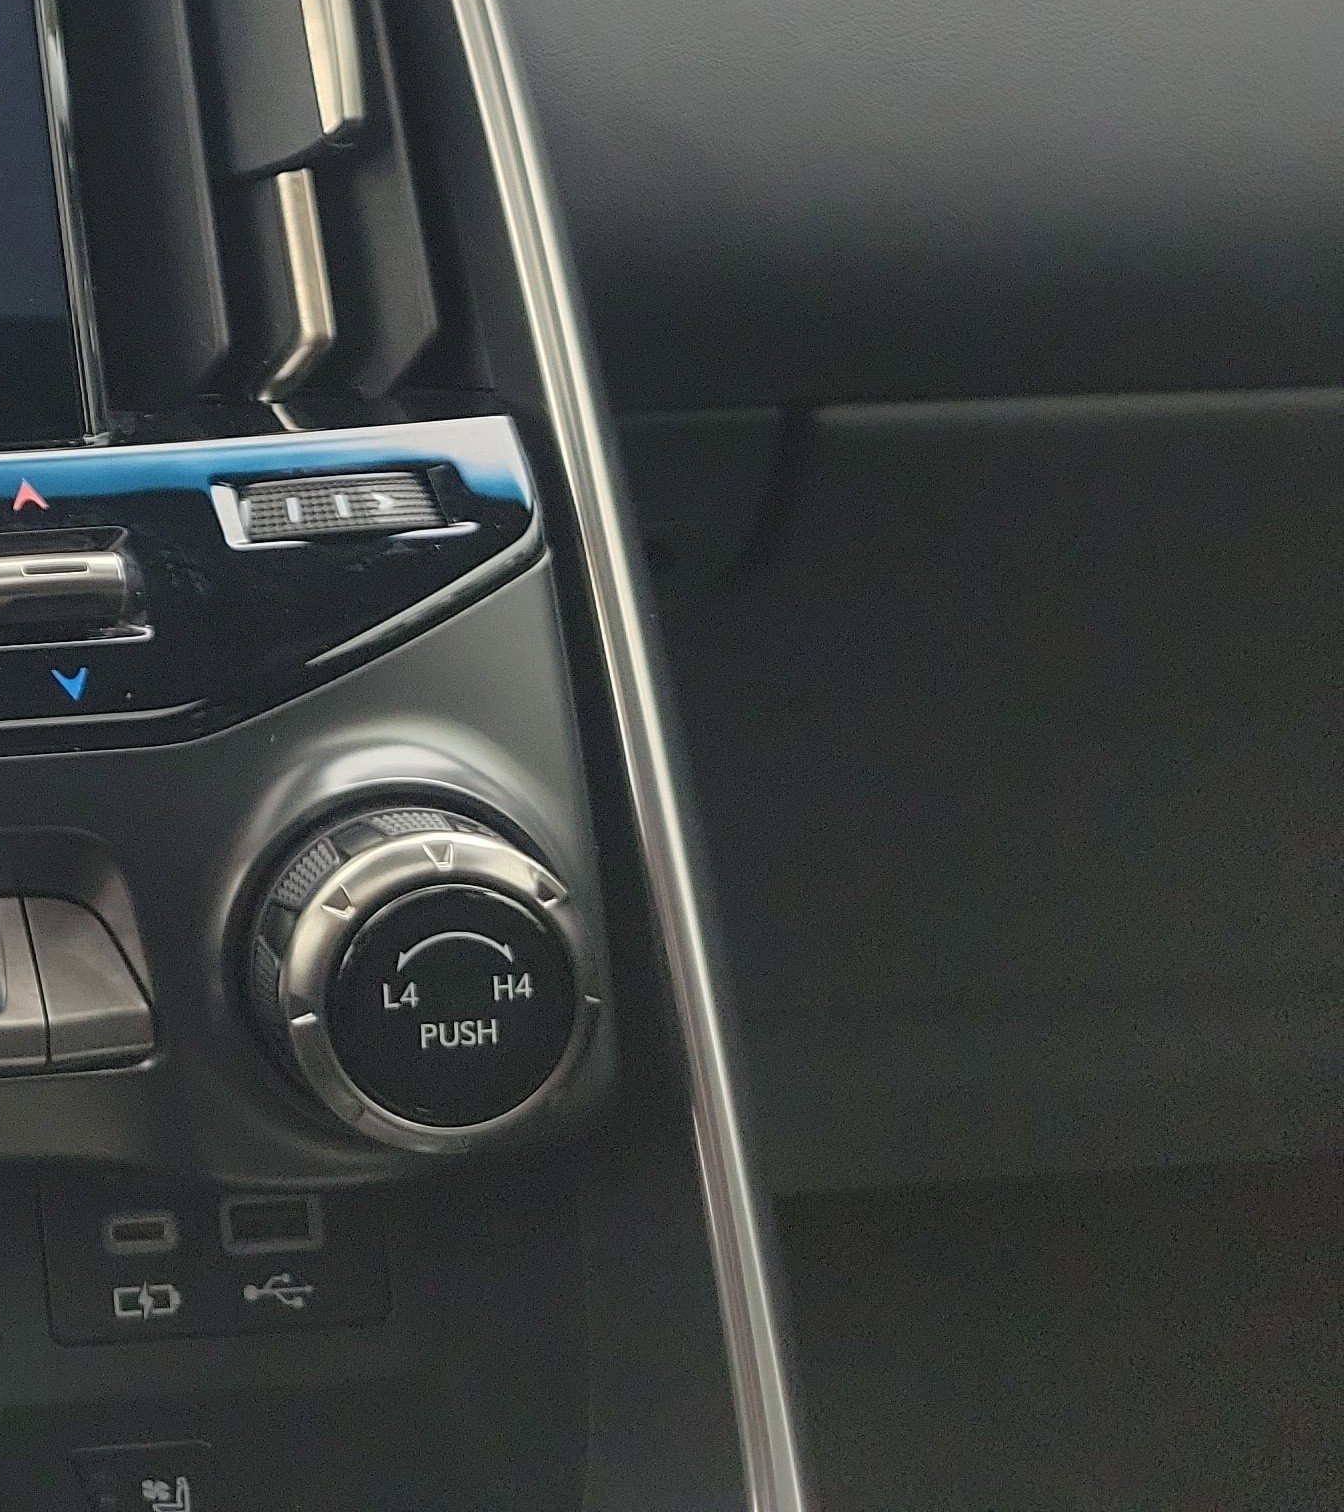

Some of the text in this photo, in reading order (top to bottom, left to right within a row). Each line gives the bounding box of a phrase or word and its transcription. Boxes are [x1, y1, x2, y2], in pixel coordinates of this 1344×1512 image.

[382, 982, 420, 1009] L4
[493, 972, 533, 1002] H4
[420, 1019, 498, 1048] PUSH
